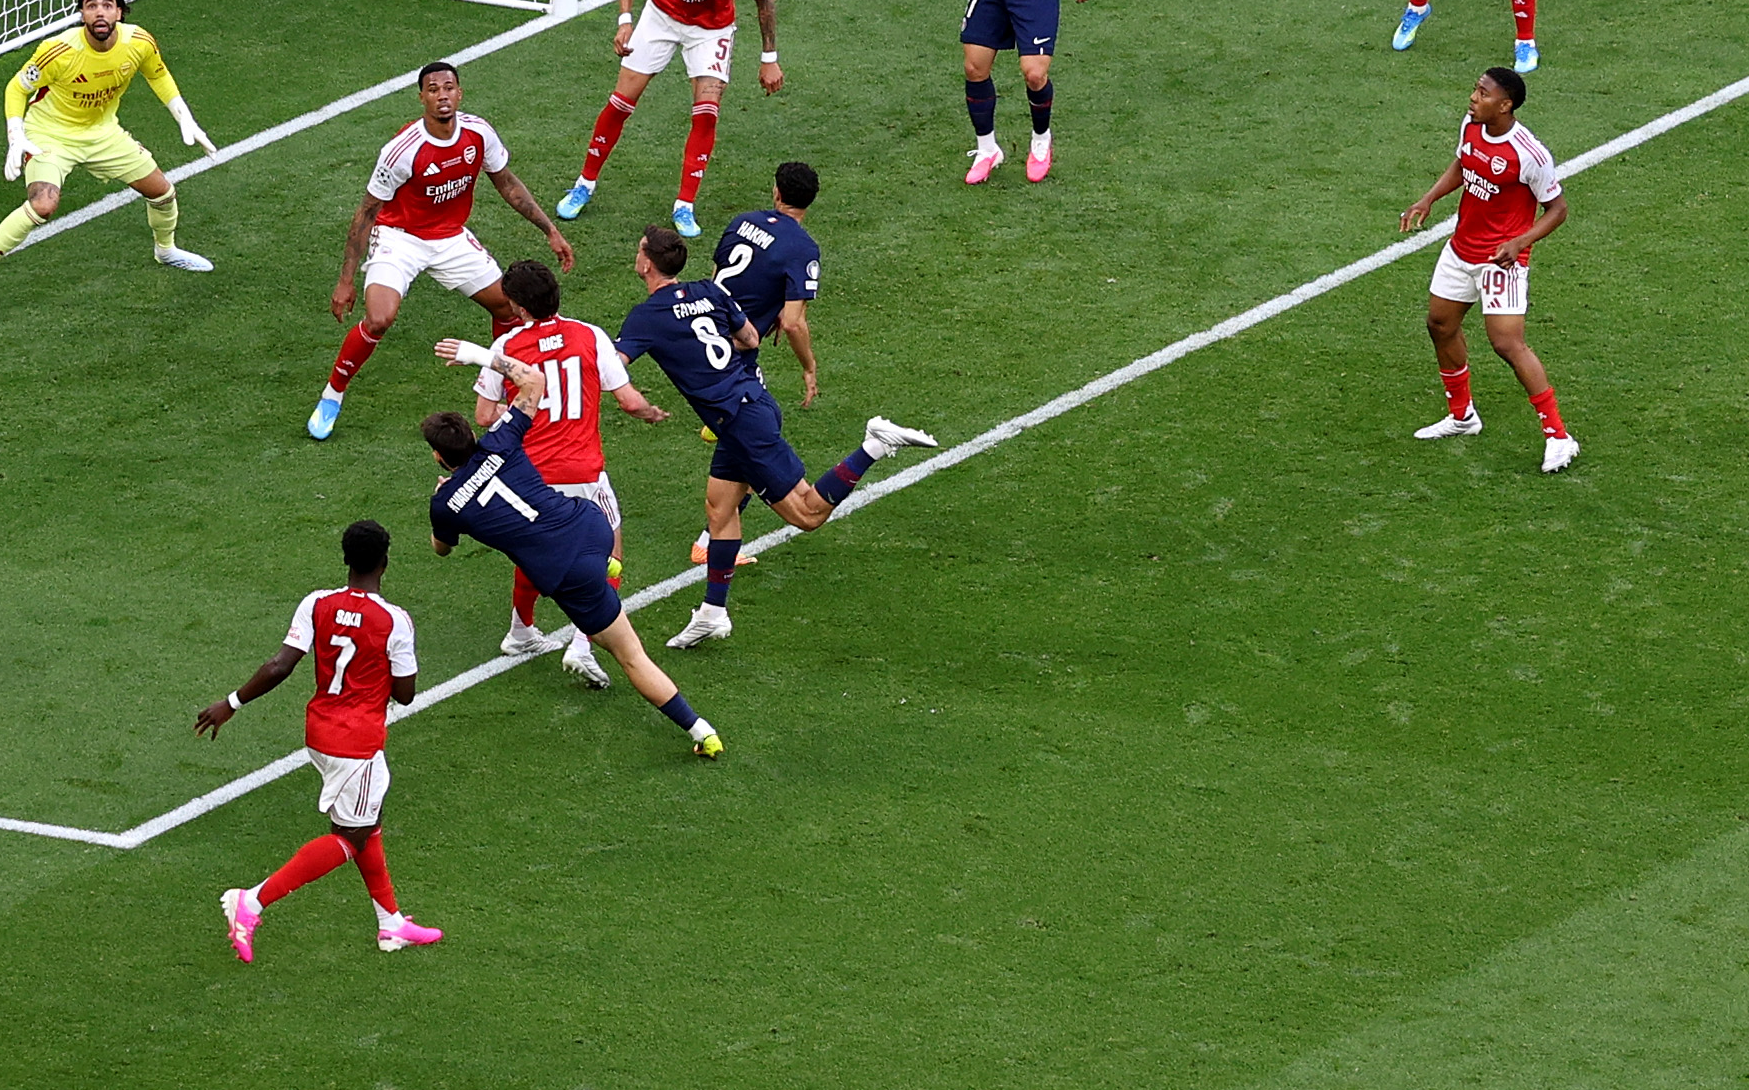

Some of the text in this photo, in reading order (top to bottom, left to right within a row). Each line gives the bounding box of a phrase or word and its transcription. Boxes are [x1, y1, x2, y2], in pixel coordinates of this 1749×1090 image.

[1463, 168, 1500, 195] mirates
[736, 220, 776, 251] HAKIMI
[714, 243, 754, 297] 2
[1482, 269, 1506, 296] 49
[538, 333, 564, 353] RICE
[690, 316, 733, 371] 8
[531, 355, 584, 423] 41
[476, 475, 540, 523] 7
[335, 608, 362, 628] SAKA
[327, 634, 357, 696] 7
